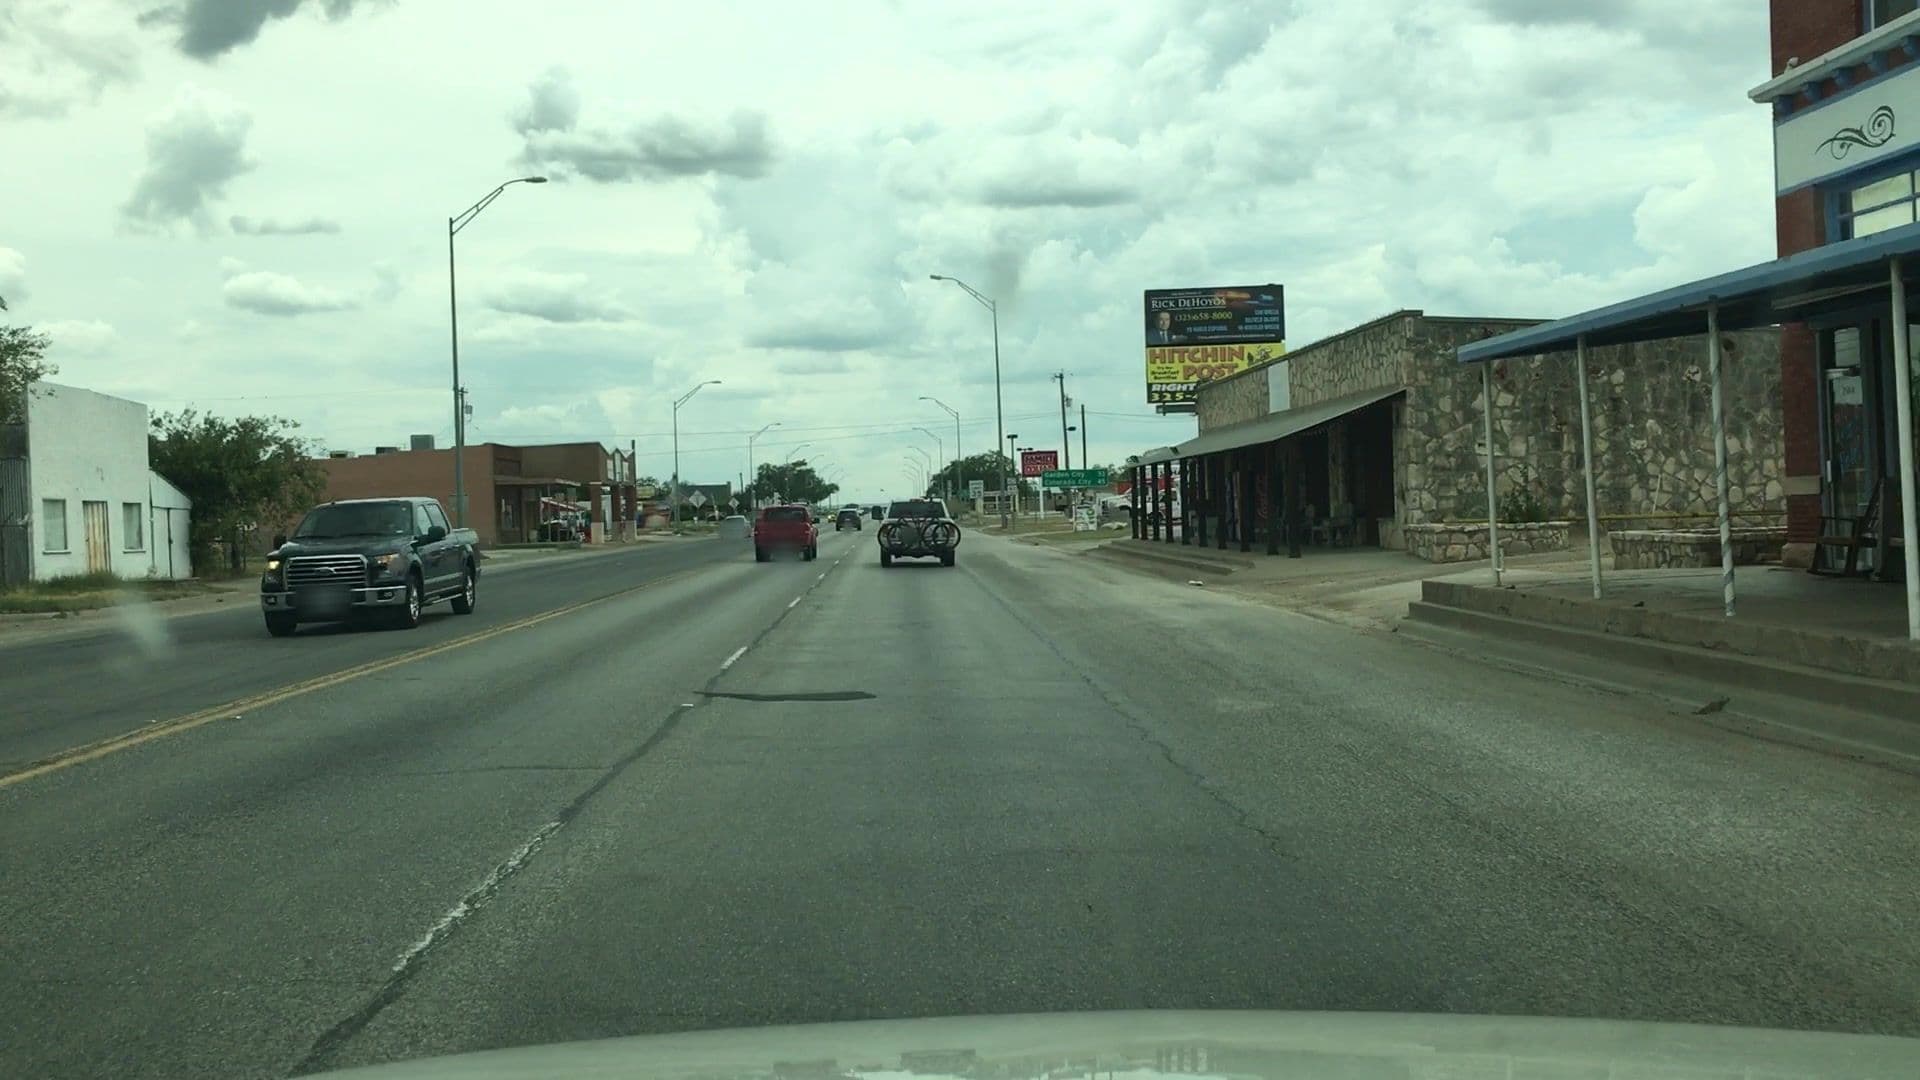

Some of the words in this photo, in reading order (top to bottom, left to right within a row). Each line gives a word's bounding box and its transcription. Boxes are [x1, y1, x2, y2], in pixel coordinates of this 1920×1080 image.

[1151, 298, 1176, 309] RICK
[1149, 346, 1245, 364] HITCHIN
[1183, 363, 1239, 380] POST
